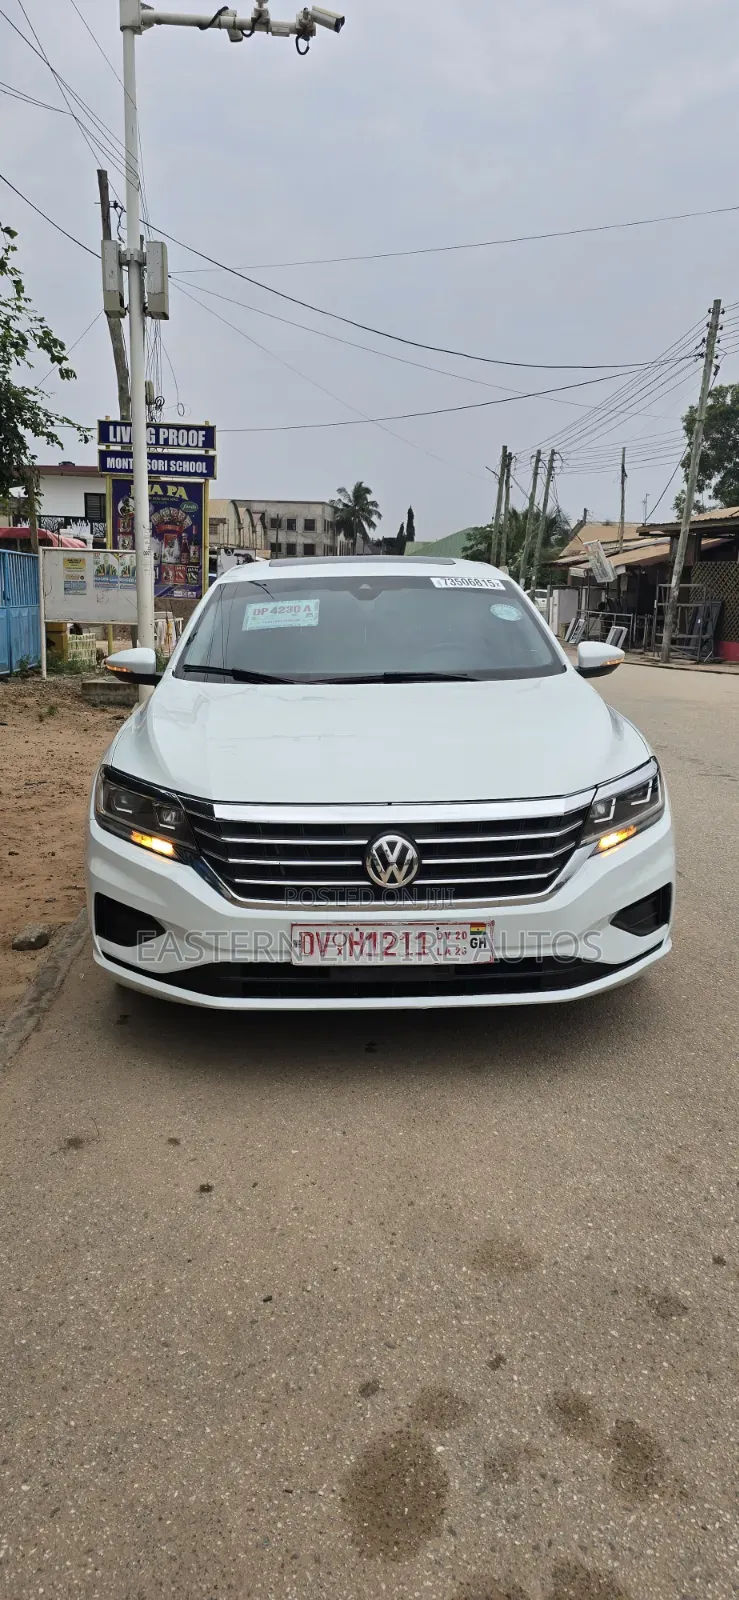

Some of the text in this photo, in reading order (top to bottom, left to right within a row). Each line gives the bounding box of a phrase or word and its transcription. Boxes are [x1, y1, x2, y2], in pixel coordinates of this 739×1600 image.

[109, 425, 206, 447] LIVG PROOF
[106, 457, 207, 473] MONTSORI SCHOOL
[167, 485, 189, 500] PA
[443, 578, 496, 588] 73506815
[252, 604, 312, 616] DP 4230 A
[455, 931, 468, 940] 20
[300, 931, 331, 957] DV
[470, 937, 486, 949] GH
